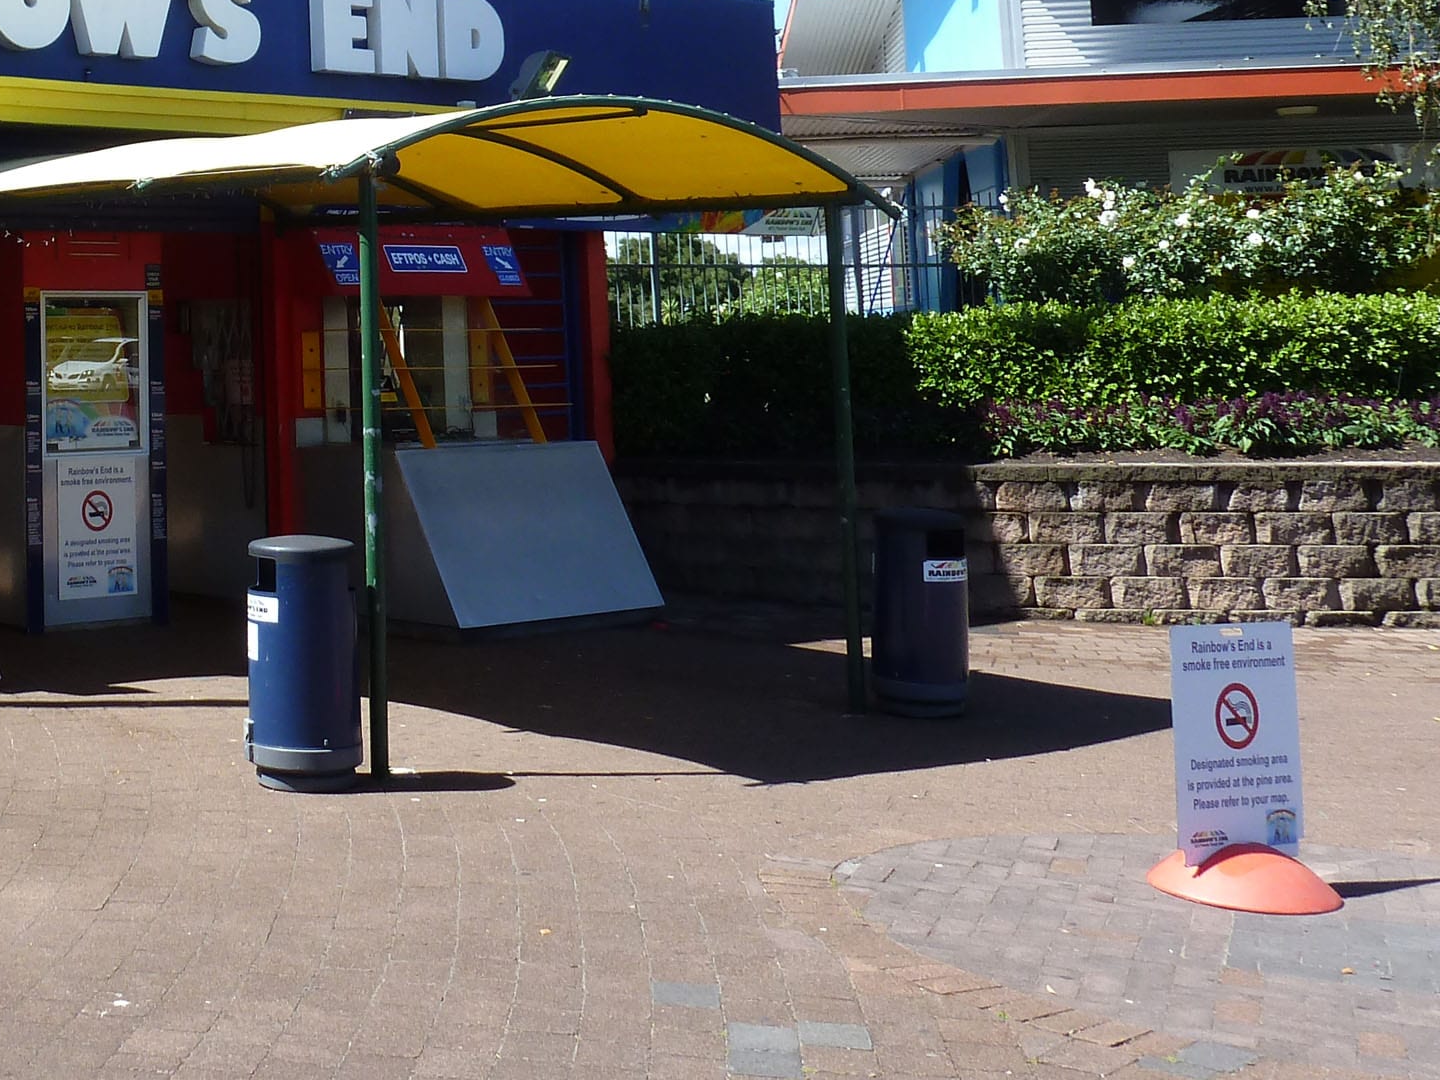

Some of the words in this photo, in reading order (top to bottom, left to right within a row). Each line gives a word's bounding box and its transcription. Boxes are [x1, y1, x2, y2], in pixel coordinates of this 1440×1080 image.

[319, 243, 354, 256] ENTRY
[482, 246, 513, 258] ENTRY
[390, 251, 428, 265] EFTPOS
[433, 252, 460, 265] CASH
[335, 273, 360, 283] OPEN
[1191, 640, 1236, 654] Rainbow's
[1237, 639, 1255, 652] End
[1257, 639, 1265, 651] is
[1266, 641, 1272, 650] a
[1182, 658, 1211, 672] smoke
[1213, 657, 1230, 670] free
[1231, 655, 1286, 670] environment
[1190, 756, 1235, 773] Designated
[1236, 754, 1270, 768] smoking
[1271, 754, 1289, 765] area
[1187, 779, 1195, 792] is
[1196, 776, 1231, 794] provided
[1232, 777, 1241, 788] at
[1241, 775, 1255, 787] the
[1193, 798, 1220, 811] Please
[1221, 795, 1240, 808] refer
[1241, 795, 1250, 807] to
[1250, 795, 1269, 809] your
